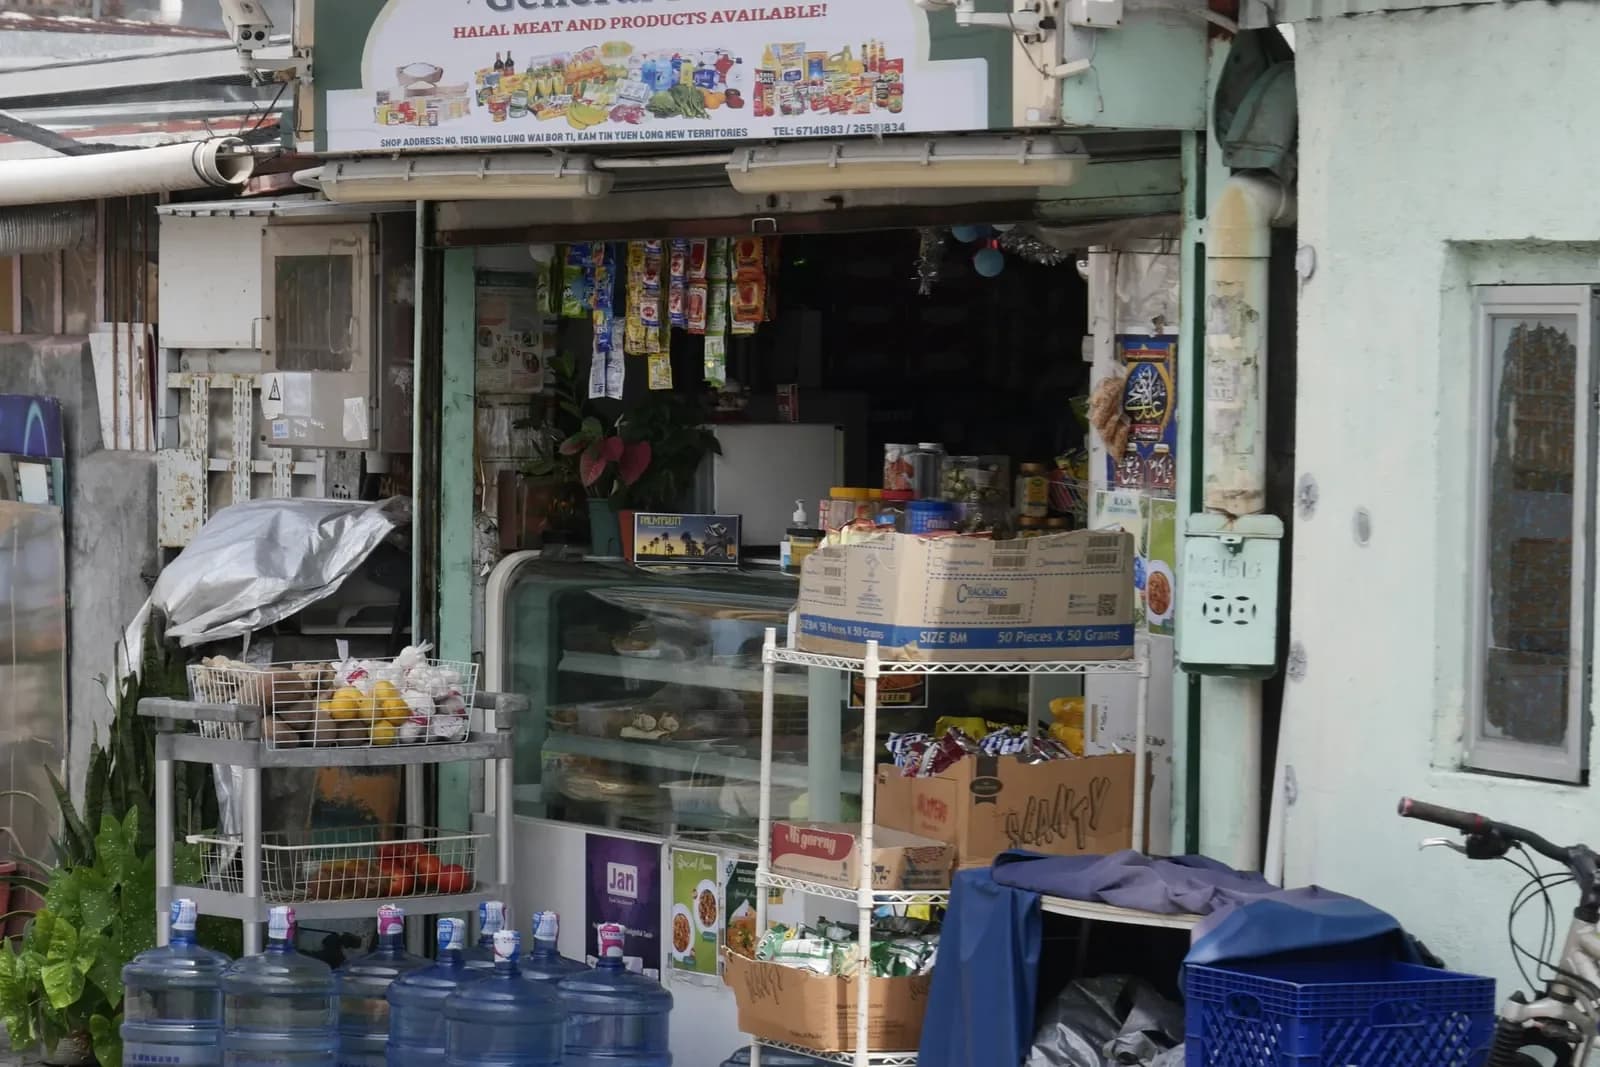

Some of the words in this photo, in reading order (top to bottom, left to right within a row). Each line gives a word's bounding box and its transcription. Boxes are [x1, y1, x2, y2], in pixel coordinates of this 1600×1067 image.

[453, 25, 509, 39] HALAL
[513, 20, 563, 35] MEAT
[566, 18, 606, 33] AND
[610, 12, 707, 30] PRODUCTS
[711, 3, 828, 24] AVAILABLE!
[380, 138, 401, 147] SHOP
[403, 136, 444, 146] ADDRESS:
[445, 136, 458, 145] NO.
[480, 134, 501, 144] WING
[503, 133, 525, 143] LUNG
[528, 133, 545, 142] WAI
[546, 132, 563, 142] BOR
[578, 131, 597, 141] KAM
[599, 131, 613, 140] TIN
[615, 130, 638, 140] YUEN
[639, 130, 664, 140] LONG
[665, 129, 686, 139] NEW
[687, 127, 748, 138] TERRITORIES
[773, 126, 794, 136] TEL:
[796, 124, 844, 135] 67141983
[919, 631, 945, 644] SIZE
[950, 631, 968, 643] BM
[997, 631, 1013, 643] 50
[1015, 630, 1053, 642] Pieces
[1055, 630, 1065, 642] X
[1067, 629, 1082, 641] 50
[1084, 628, 1121, 641] Grams
[609, 867, 635, 892] Jan
